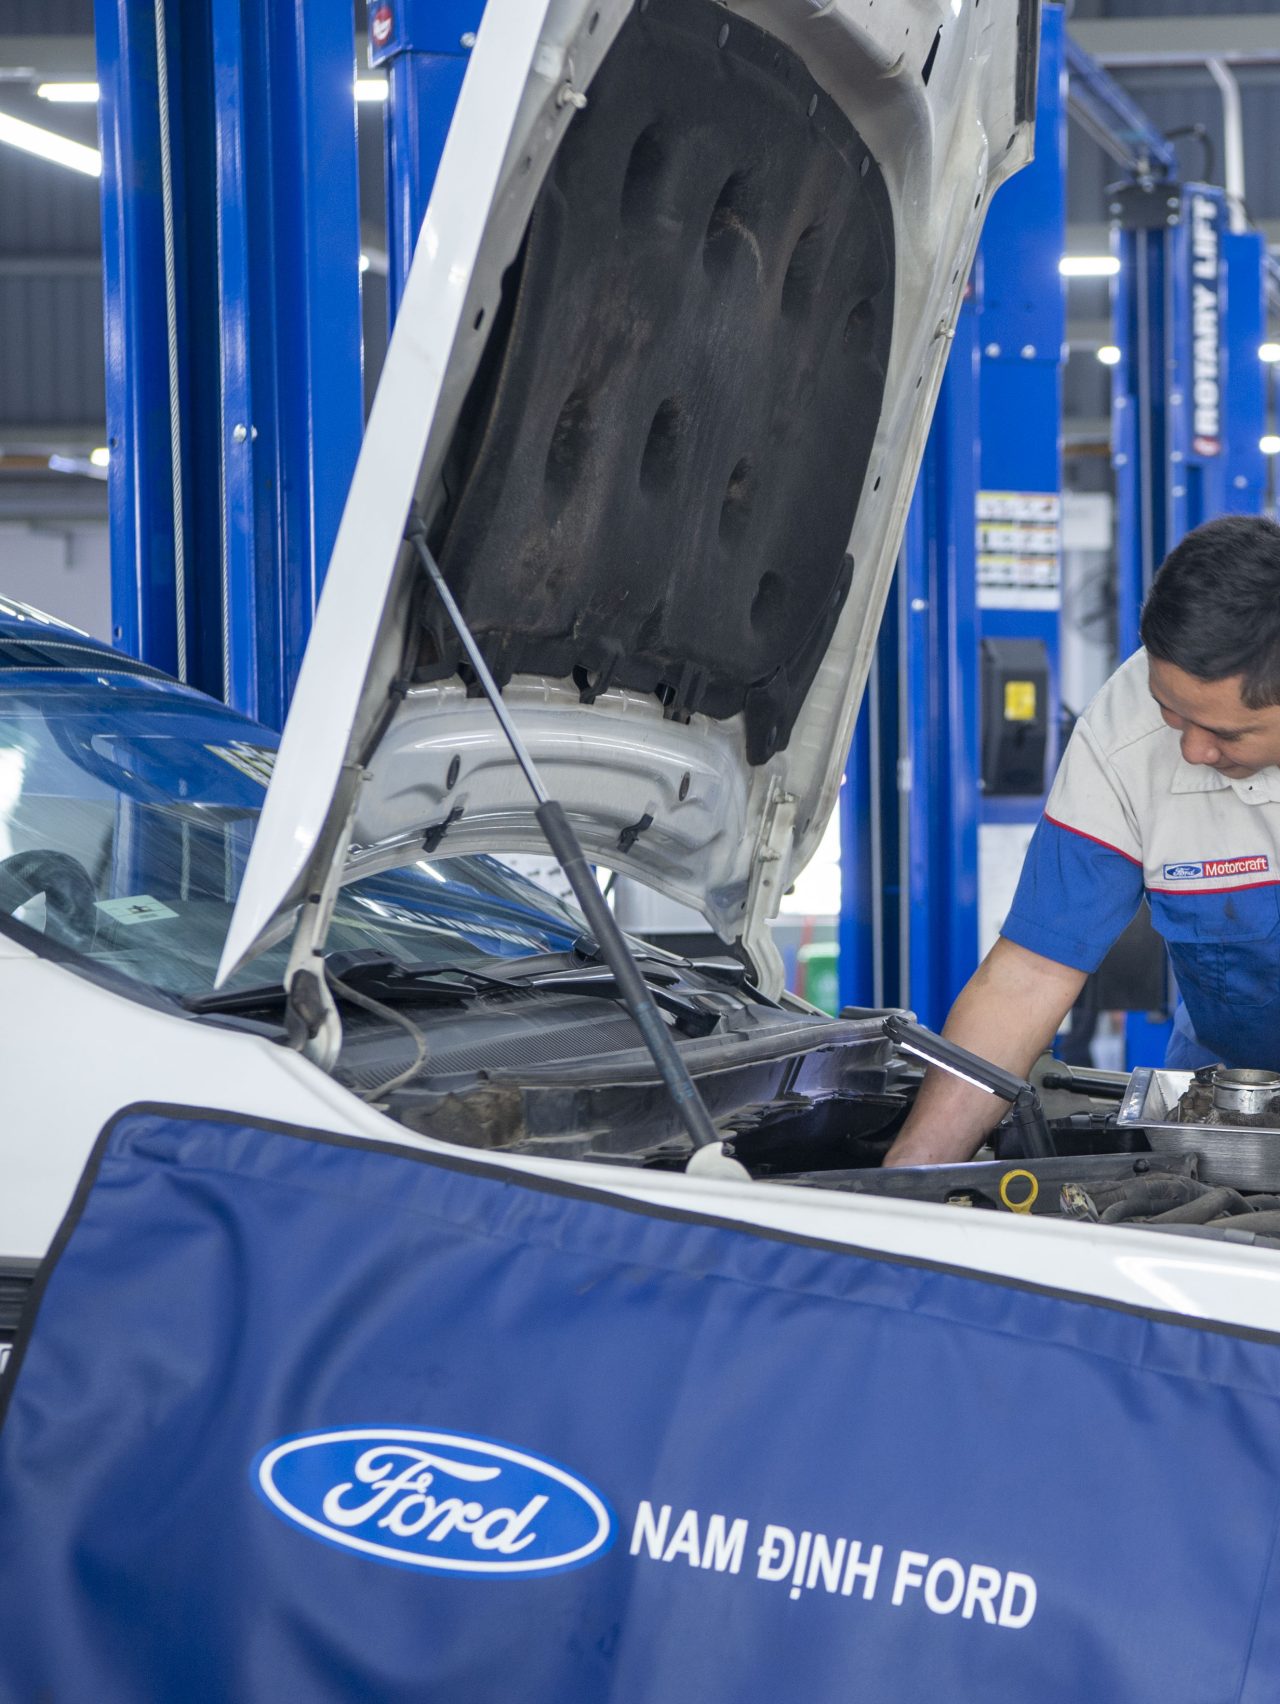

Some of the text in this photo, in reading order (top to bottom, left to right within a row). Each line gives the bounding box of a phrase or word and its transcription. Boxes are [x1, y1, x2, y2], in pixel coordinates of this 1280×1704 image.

[1192, 195, 1219, 435] ROTARY LIFT
[1205, 858, 1267, 876] Motorcraft
[322, 1446, 550, 1554] Ford
[629, 1500, 1038, 1630] NAM ĐỊNH FORD
